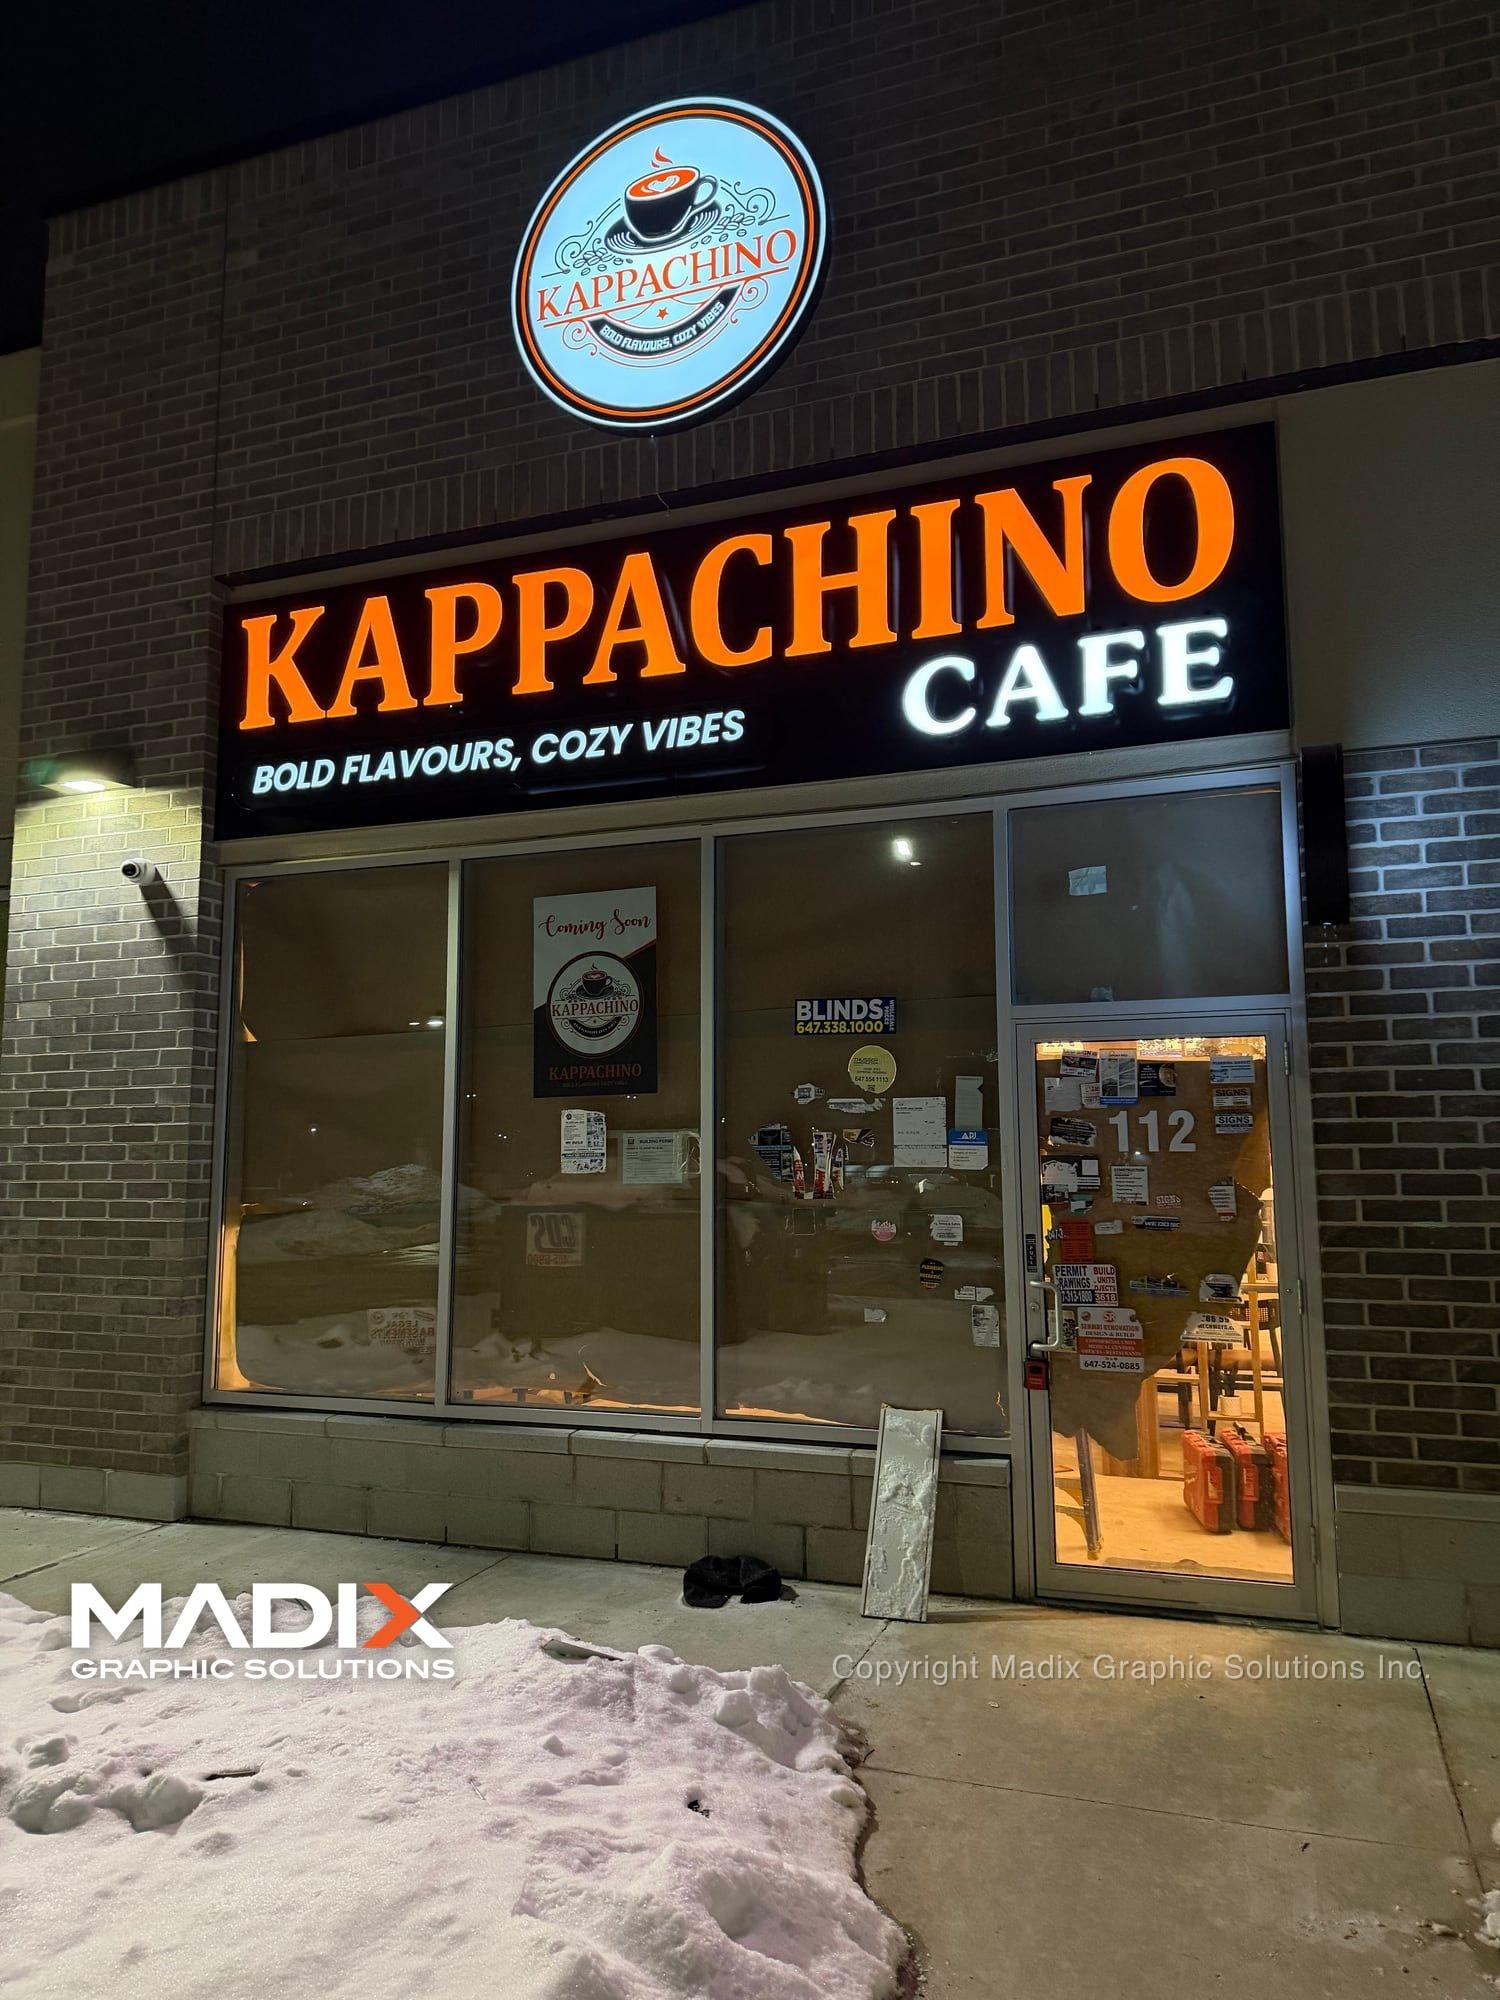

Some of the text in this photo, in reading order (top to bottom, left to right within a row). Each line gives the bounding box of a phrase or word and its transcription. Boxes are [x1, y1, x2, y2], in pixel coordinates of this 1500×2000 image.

[537, 228, 798, 322] KAPPACHINO
[599, 324, 624, 345] BOLD
[672, 324, 698, 346] COZY
[696, 300, 726, 330] VIBES
[239, 456, 1236, 731] KAPPACHINO
[902, 617, 1236, 737] CAFE
[252, 709, 745, 795] BOLD FLAVOURS, COZY VIBES
[538, 909, 652, 940] Coming Soon
[551, 1000, 639, 1017] KAPPACHINO
[796, 998, 884, 1021] BLINDS
[796, 1020, 884, 1034] 647.338.1000
[549, 1063, 642, 1081] KAPPACHINO
[1215, 1088, 1248, 1097] SIGNS
[1108, 1109, 1197, 1152] 112
[1218, 1116, 1250, 1124] SIGNS
[1055, 1266, 1088, 1277] PERMIT
[1093, 1266, 1115, 1275] BUILD
